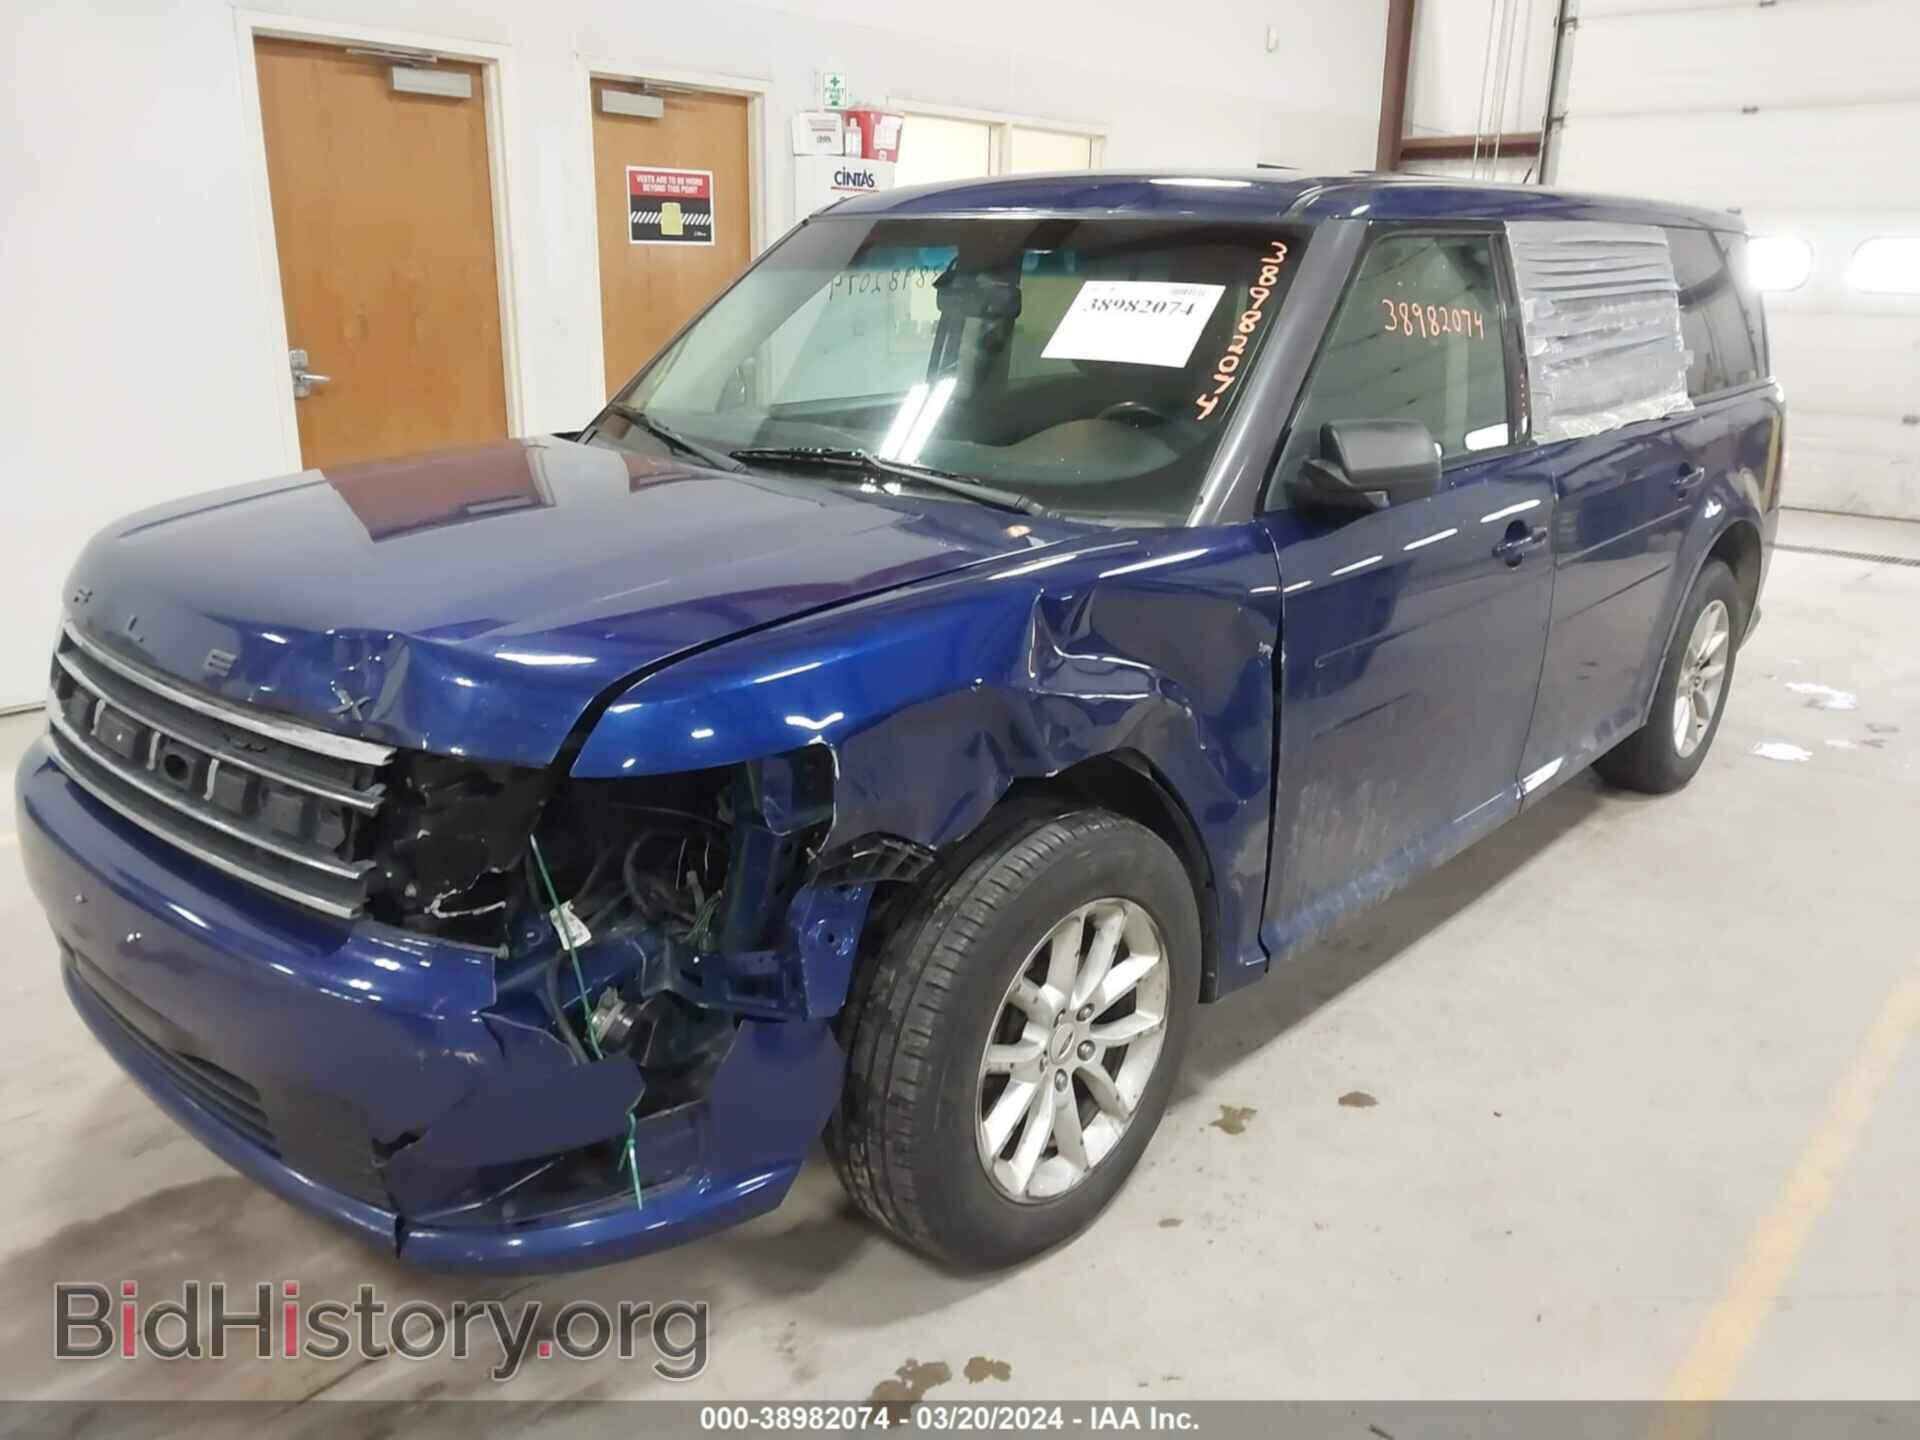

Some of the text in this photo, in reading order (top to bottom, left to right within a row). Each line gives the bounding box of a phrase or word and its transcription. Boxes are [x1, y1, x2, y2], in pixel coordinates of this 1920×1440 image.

[1082, 297, 1195, 316] 38982074
[1381, 298, 1485, 341] 38982074
[1195, 240, 1289, 421] 38982074
